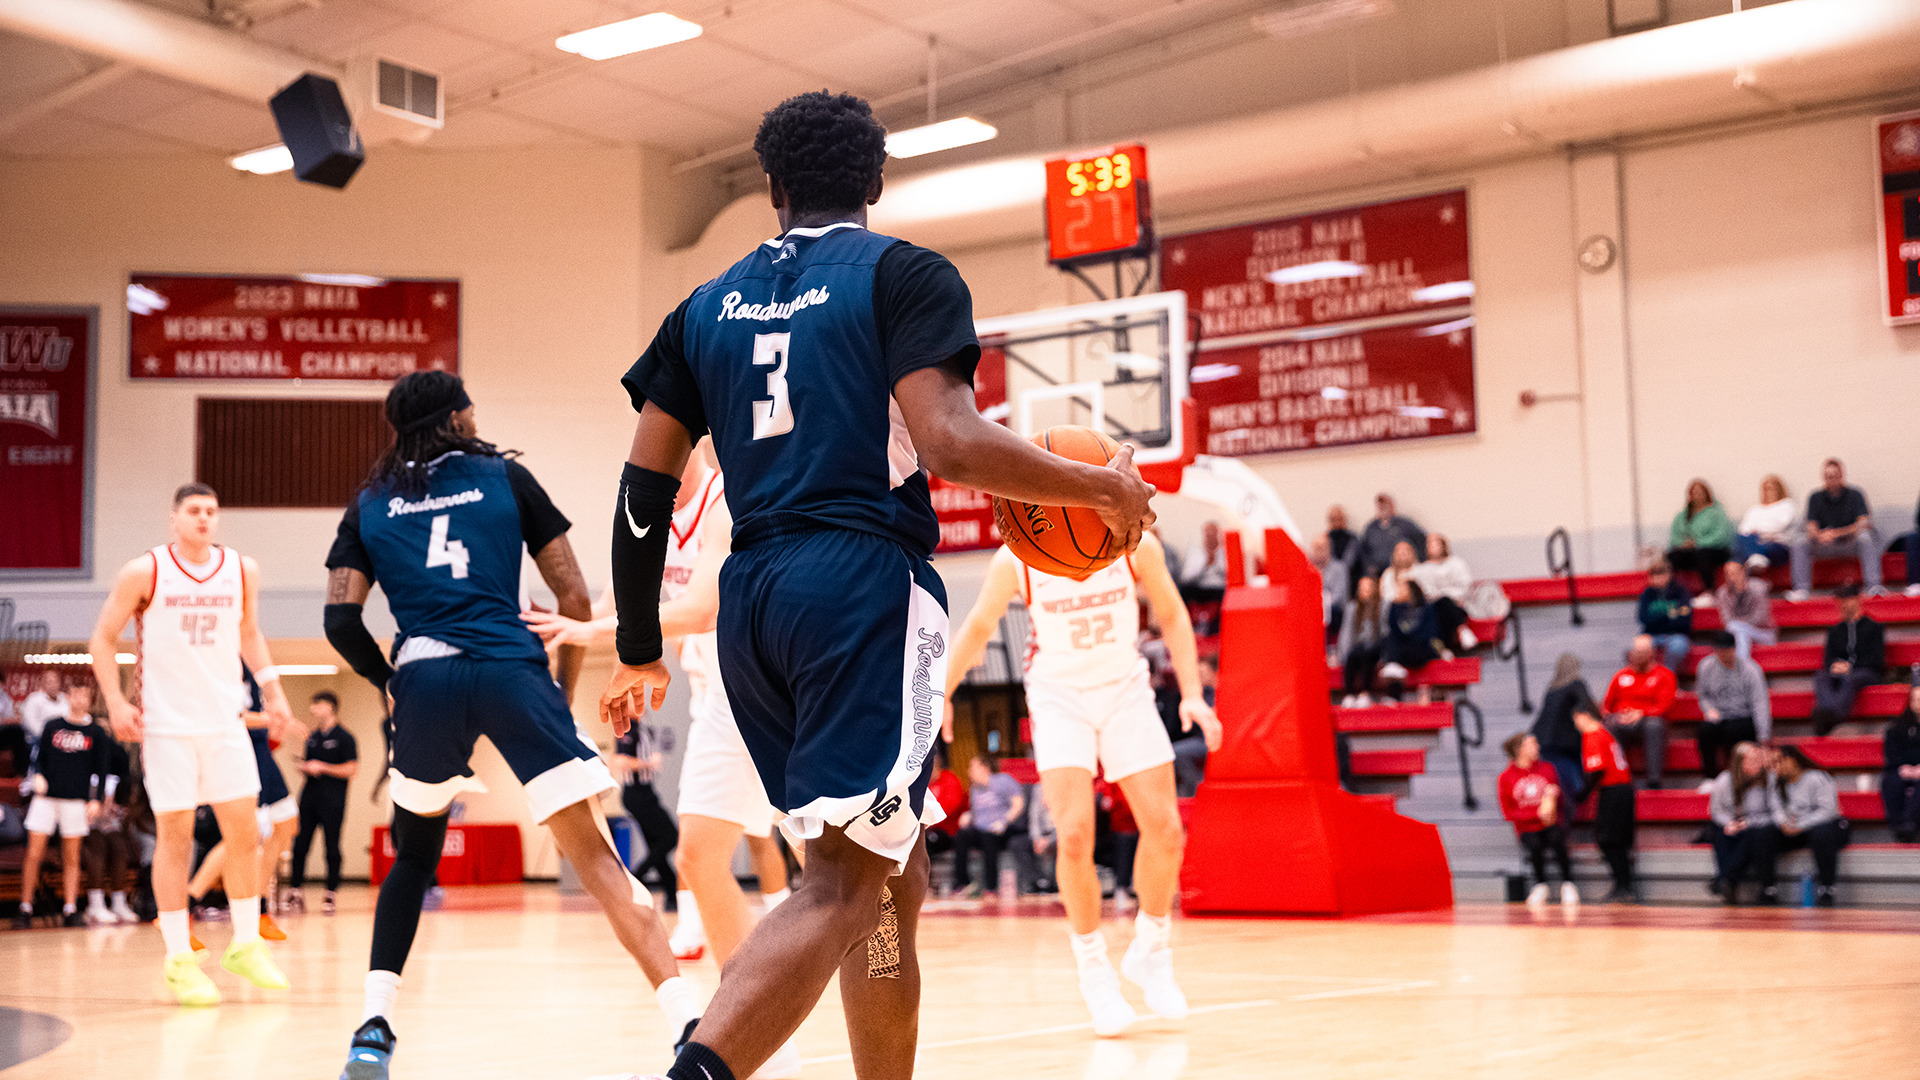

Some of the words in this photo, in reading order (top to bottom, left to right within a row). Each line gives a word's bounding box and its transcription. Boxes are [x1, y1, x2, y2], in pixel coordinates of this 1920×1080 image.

[1066, 153, 1131, 197] 5:33
[1065, 192, 1122, 252] 27
[1311, 214, 1364, 245] NAIA
[234, 285, 295, 311] 2023
[303, 286, 360, 310] NAIA
[1202, 280, 1266, 309] MEN'S
[163, 316, 269, 341] WOMEN'S
[279, 318, 430, 344] VOLLEYBALL
[1201, 301, 1304, 335] NATIONAL
[174, 350, 292, 375] NATIONAL
[300, 351, 418, 377] CHAMPION
[1311, 336, 1366, 368] NAIA
[752, 332, 795, 441] 3
[1258, 366, 1351, 399] DIVISION
[1208, 400, 1276, 430] MEN'S
[1277, 382, 1423, 422] BASKETBALL
[1207, 422, 1311, 455] NATIONAL
[1314, 411, 1430, 444] CHAMPION
[387, 488, 484, 518] Roadrunners
[425, 514, 470, 579] 4
[182, 614, 217, 645] 42
[1068, 613, 1116, 650] 22
[906, 627, 945, 772] Roadrunners
